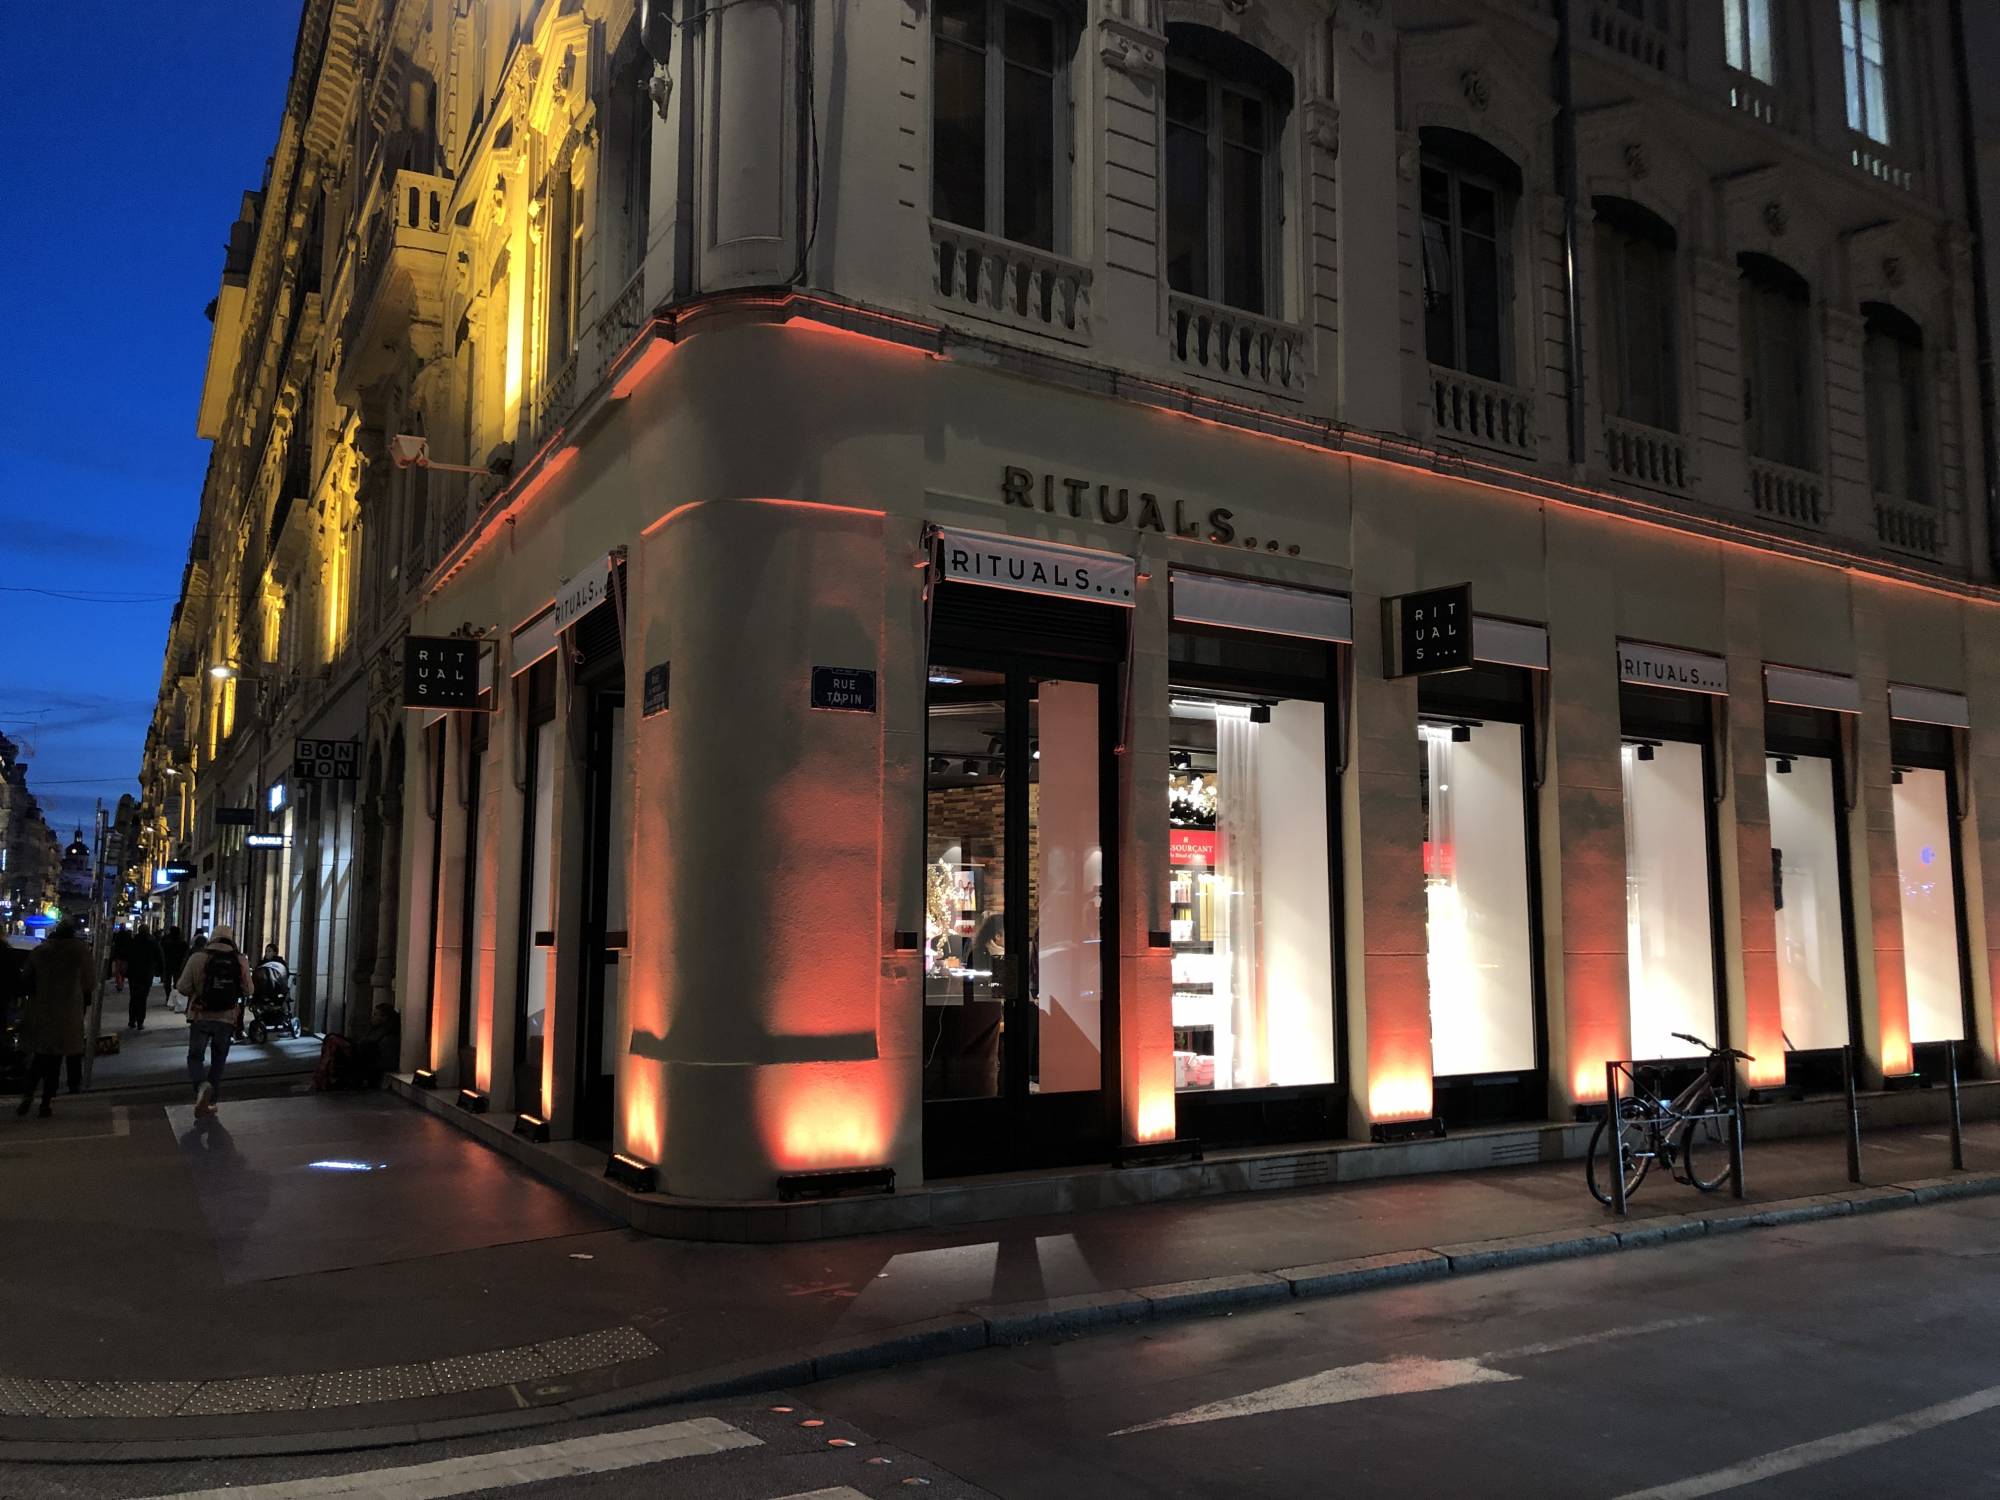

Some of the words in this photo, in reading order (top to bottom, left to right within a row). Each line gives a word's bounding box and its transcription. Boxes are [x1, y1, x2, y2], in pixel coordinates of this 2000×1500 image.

[1002, 465, 1300, 556] RITUALS...
[952, 549, 1130, 597] RITUALS...
[1625, 659, 1721, 687] RITUALS...
[833, 679, 856, 690] RUE
[301, 743, 350, 757] BON
[301, 762, 350, 777] TON
